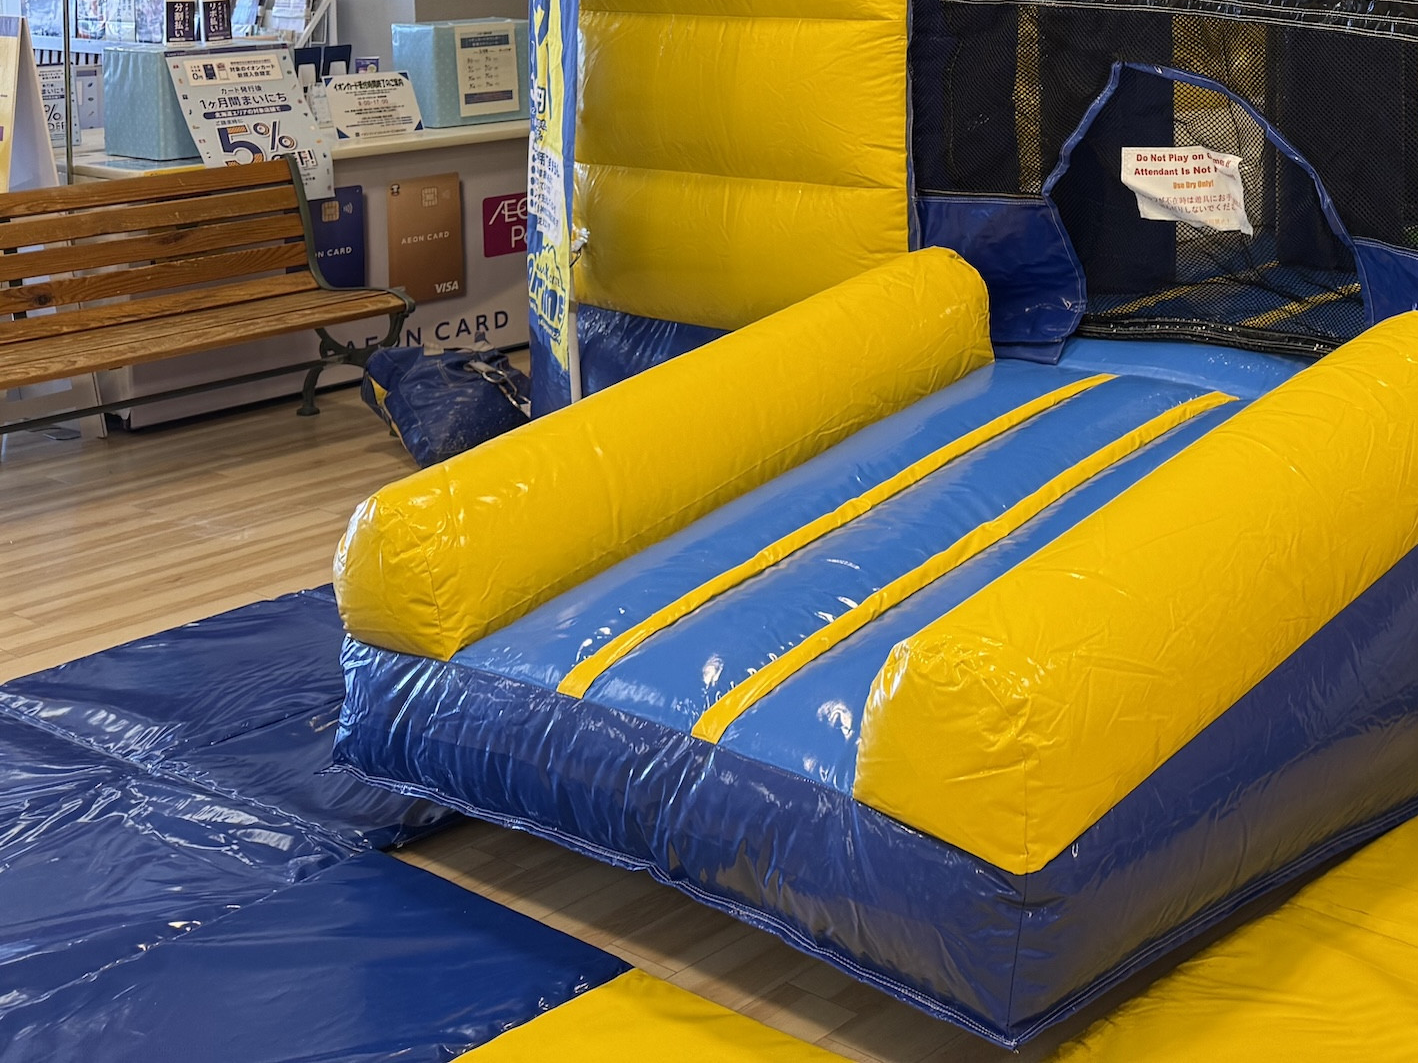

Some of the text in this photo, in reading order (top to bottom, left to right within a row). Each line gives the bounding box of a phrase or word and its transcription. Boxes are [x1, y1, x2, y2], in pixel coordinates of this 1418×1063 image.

[1136, 154, 1148, 162] Do
[1150, 154, 1166, 162] Not
[1168, 153, 1189, 163] Play
[1134, 168, 1178, 176] Attendant
[1193, 166, 1211, 175] Not
[401, 231, 450, 245] AEON CARD
[327, 246, 353, 257] CARD
[435, 281, 459, 294] VISA
[435, 310, 509, 341] CARD
